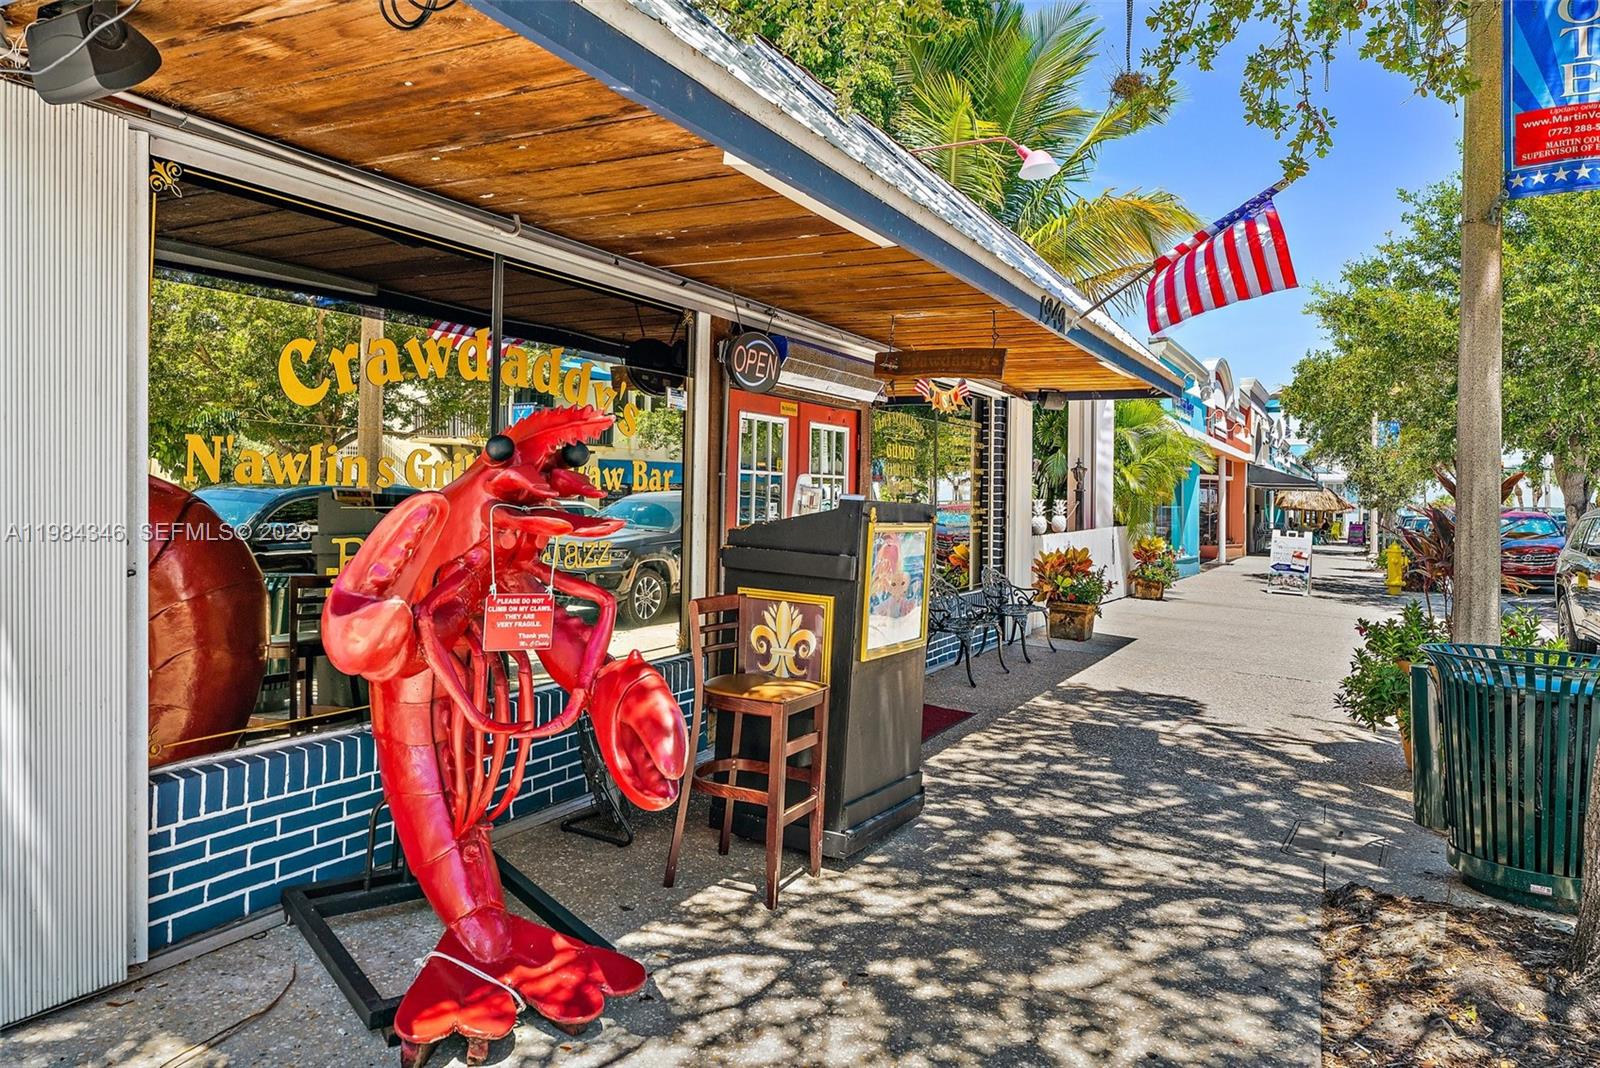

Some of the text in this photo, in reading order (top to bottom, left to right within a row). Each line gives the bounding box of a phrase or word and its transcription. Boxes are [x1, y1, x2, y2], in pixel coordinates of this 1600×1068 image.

[1548, 127, 1572, 138] (772)
[1521, 146, 1579, 161] SUPERVISOR
[1580, 144, 1593, 152] OF
[1545, 137, 1582, 150] MARTIN
[734, 345, 778, 380] OPEN
[278, 327, 640, 438] Crawdaddy's
[886, 442, 916, 460] GUMBO
[631, 459, 674, 492] Bar
